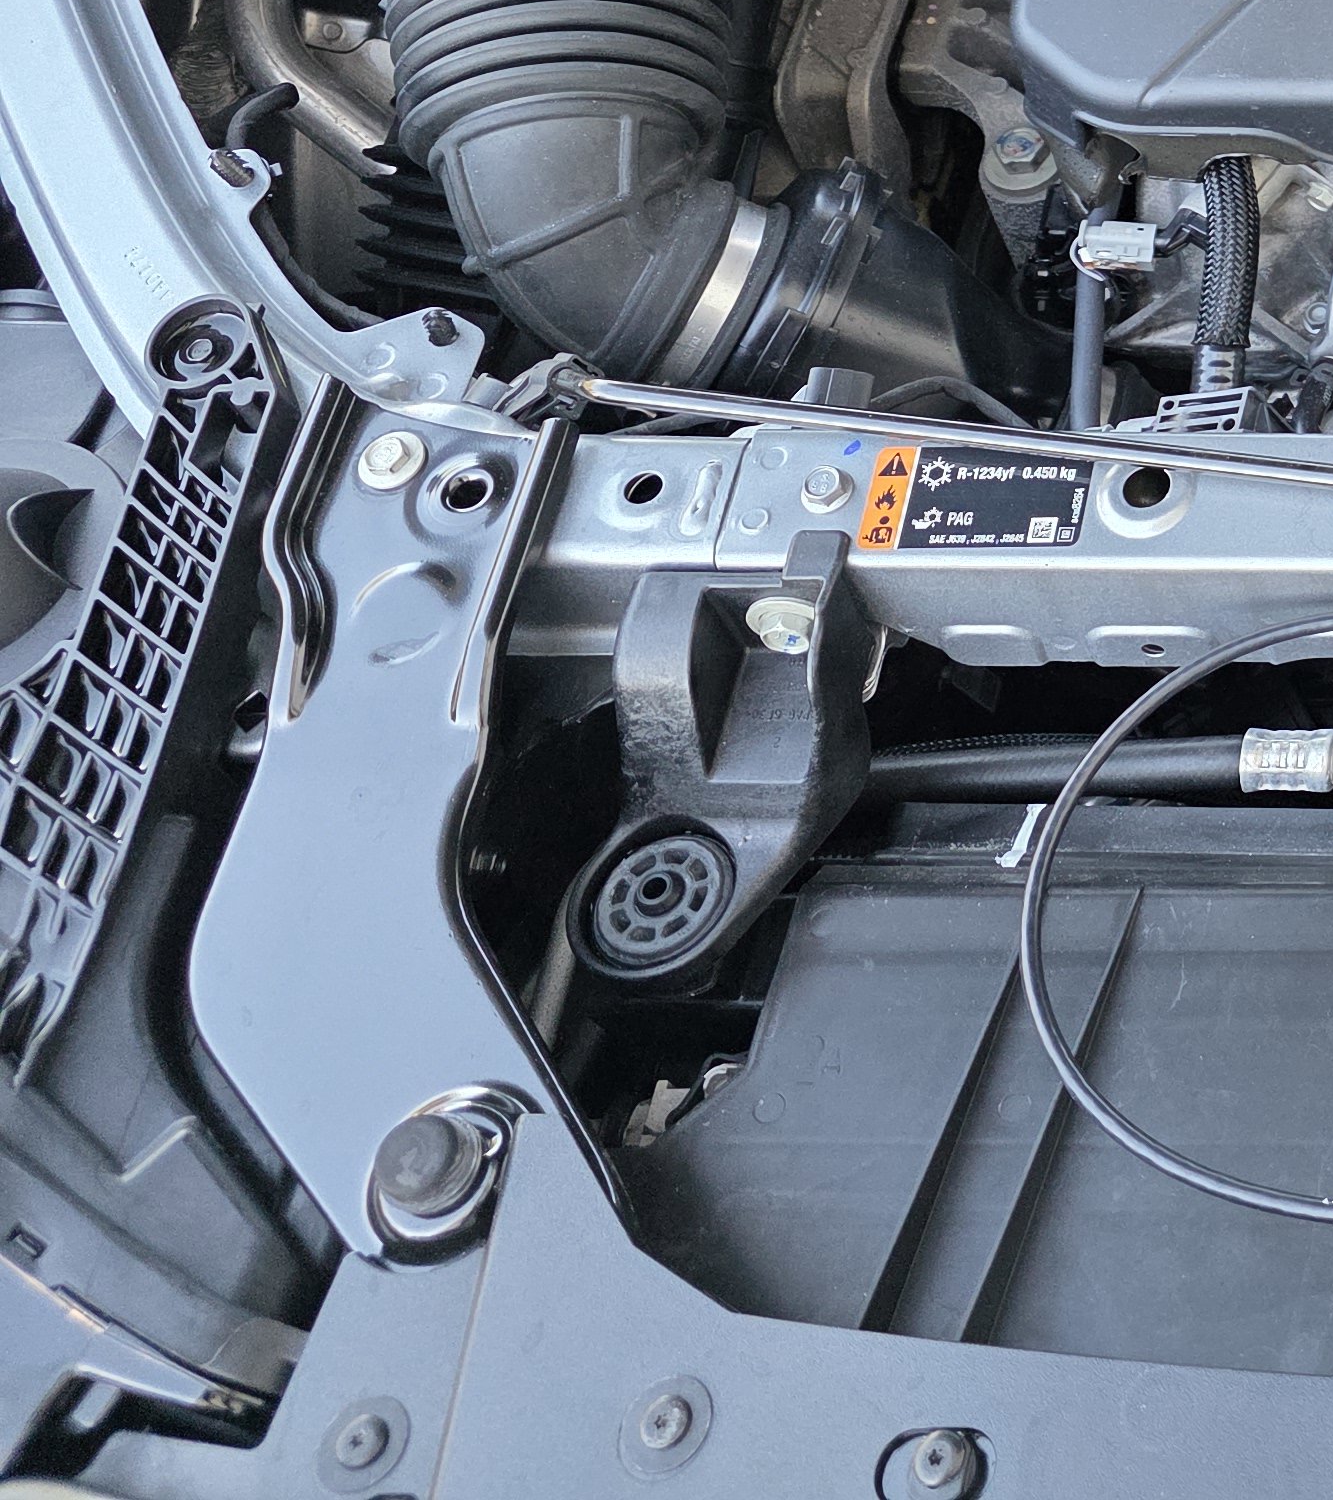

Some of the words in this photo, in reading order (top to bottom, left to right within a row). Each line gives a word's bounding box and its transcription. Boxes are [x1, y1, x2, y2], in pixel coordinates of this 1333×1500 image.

[956, 466, 1017, 482] R-1234yf
[1021, 466, 1057, 480] 0.450
[1059, 466, 1077, 482] kg
[946, 511, 974, 526] PAG
[928, 534, 947, 544] SAE
